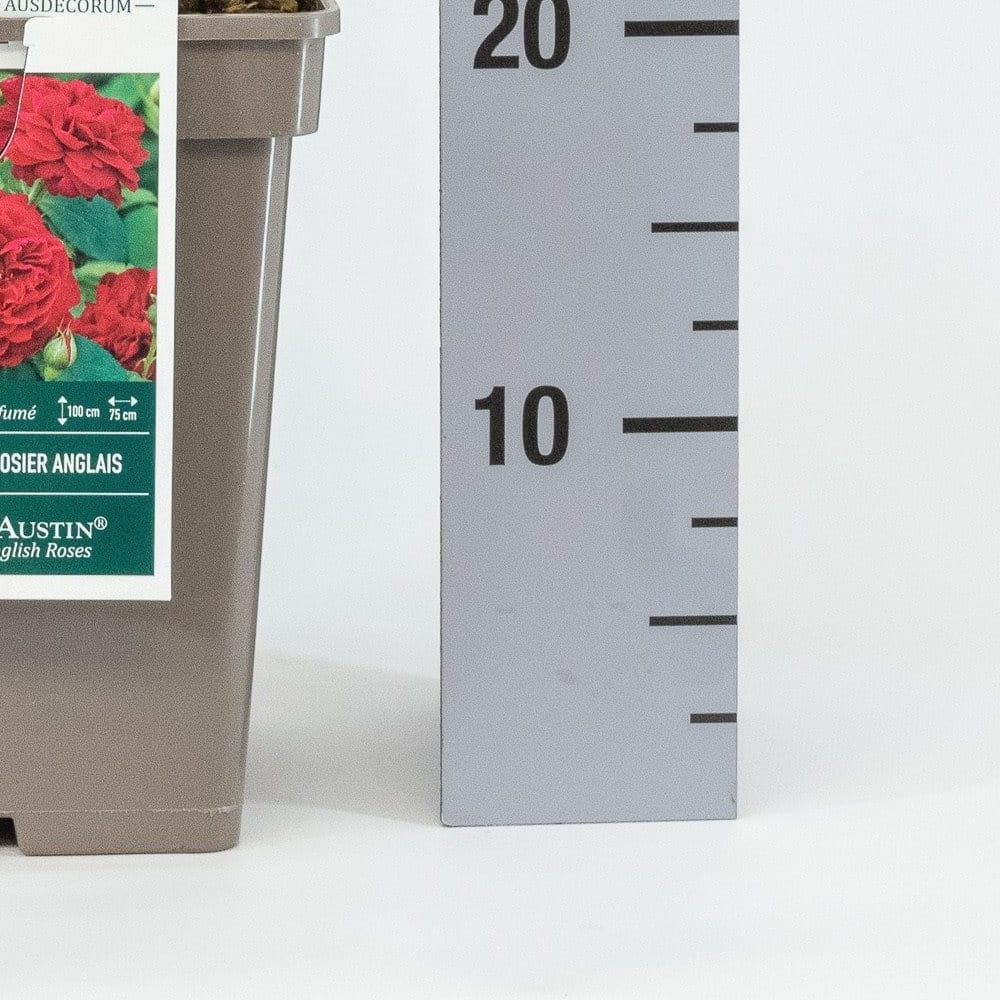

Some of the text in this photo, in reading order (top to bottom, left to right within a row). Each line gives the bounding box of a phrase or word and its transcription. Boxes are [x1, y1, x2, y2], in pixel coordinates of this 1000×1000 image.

[67, 404, 101, 418] 100 cm
[108, 408, 137, 421] 75 cm
[474, 385, 570, 466] 10
[51, 452, 123, 474] ANGLAIS
[45, 542, 93, 558] Roses
